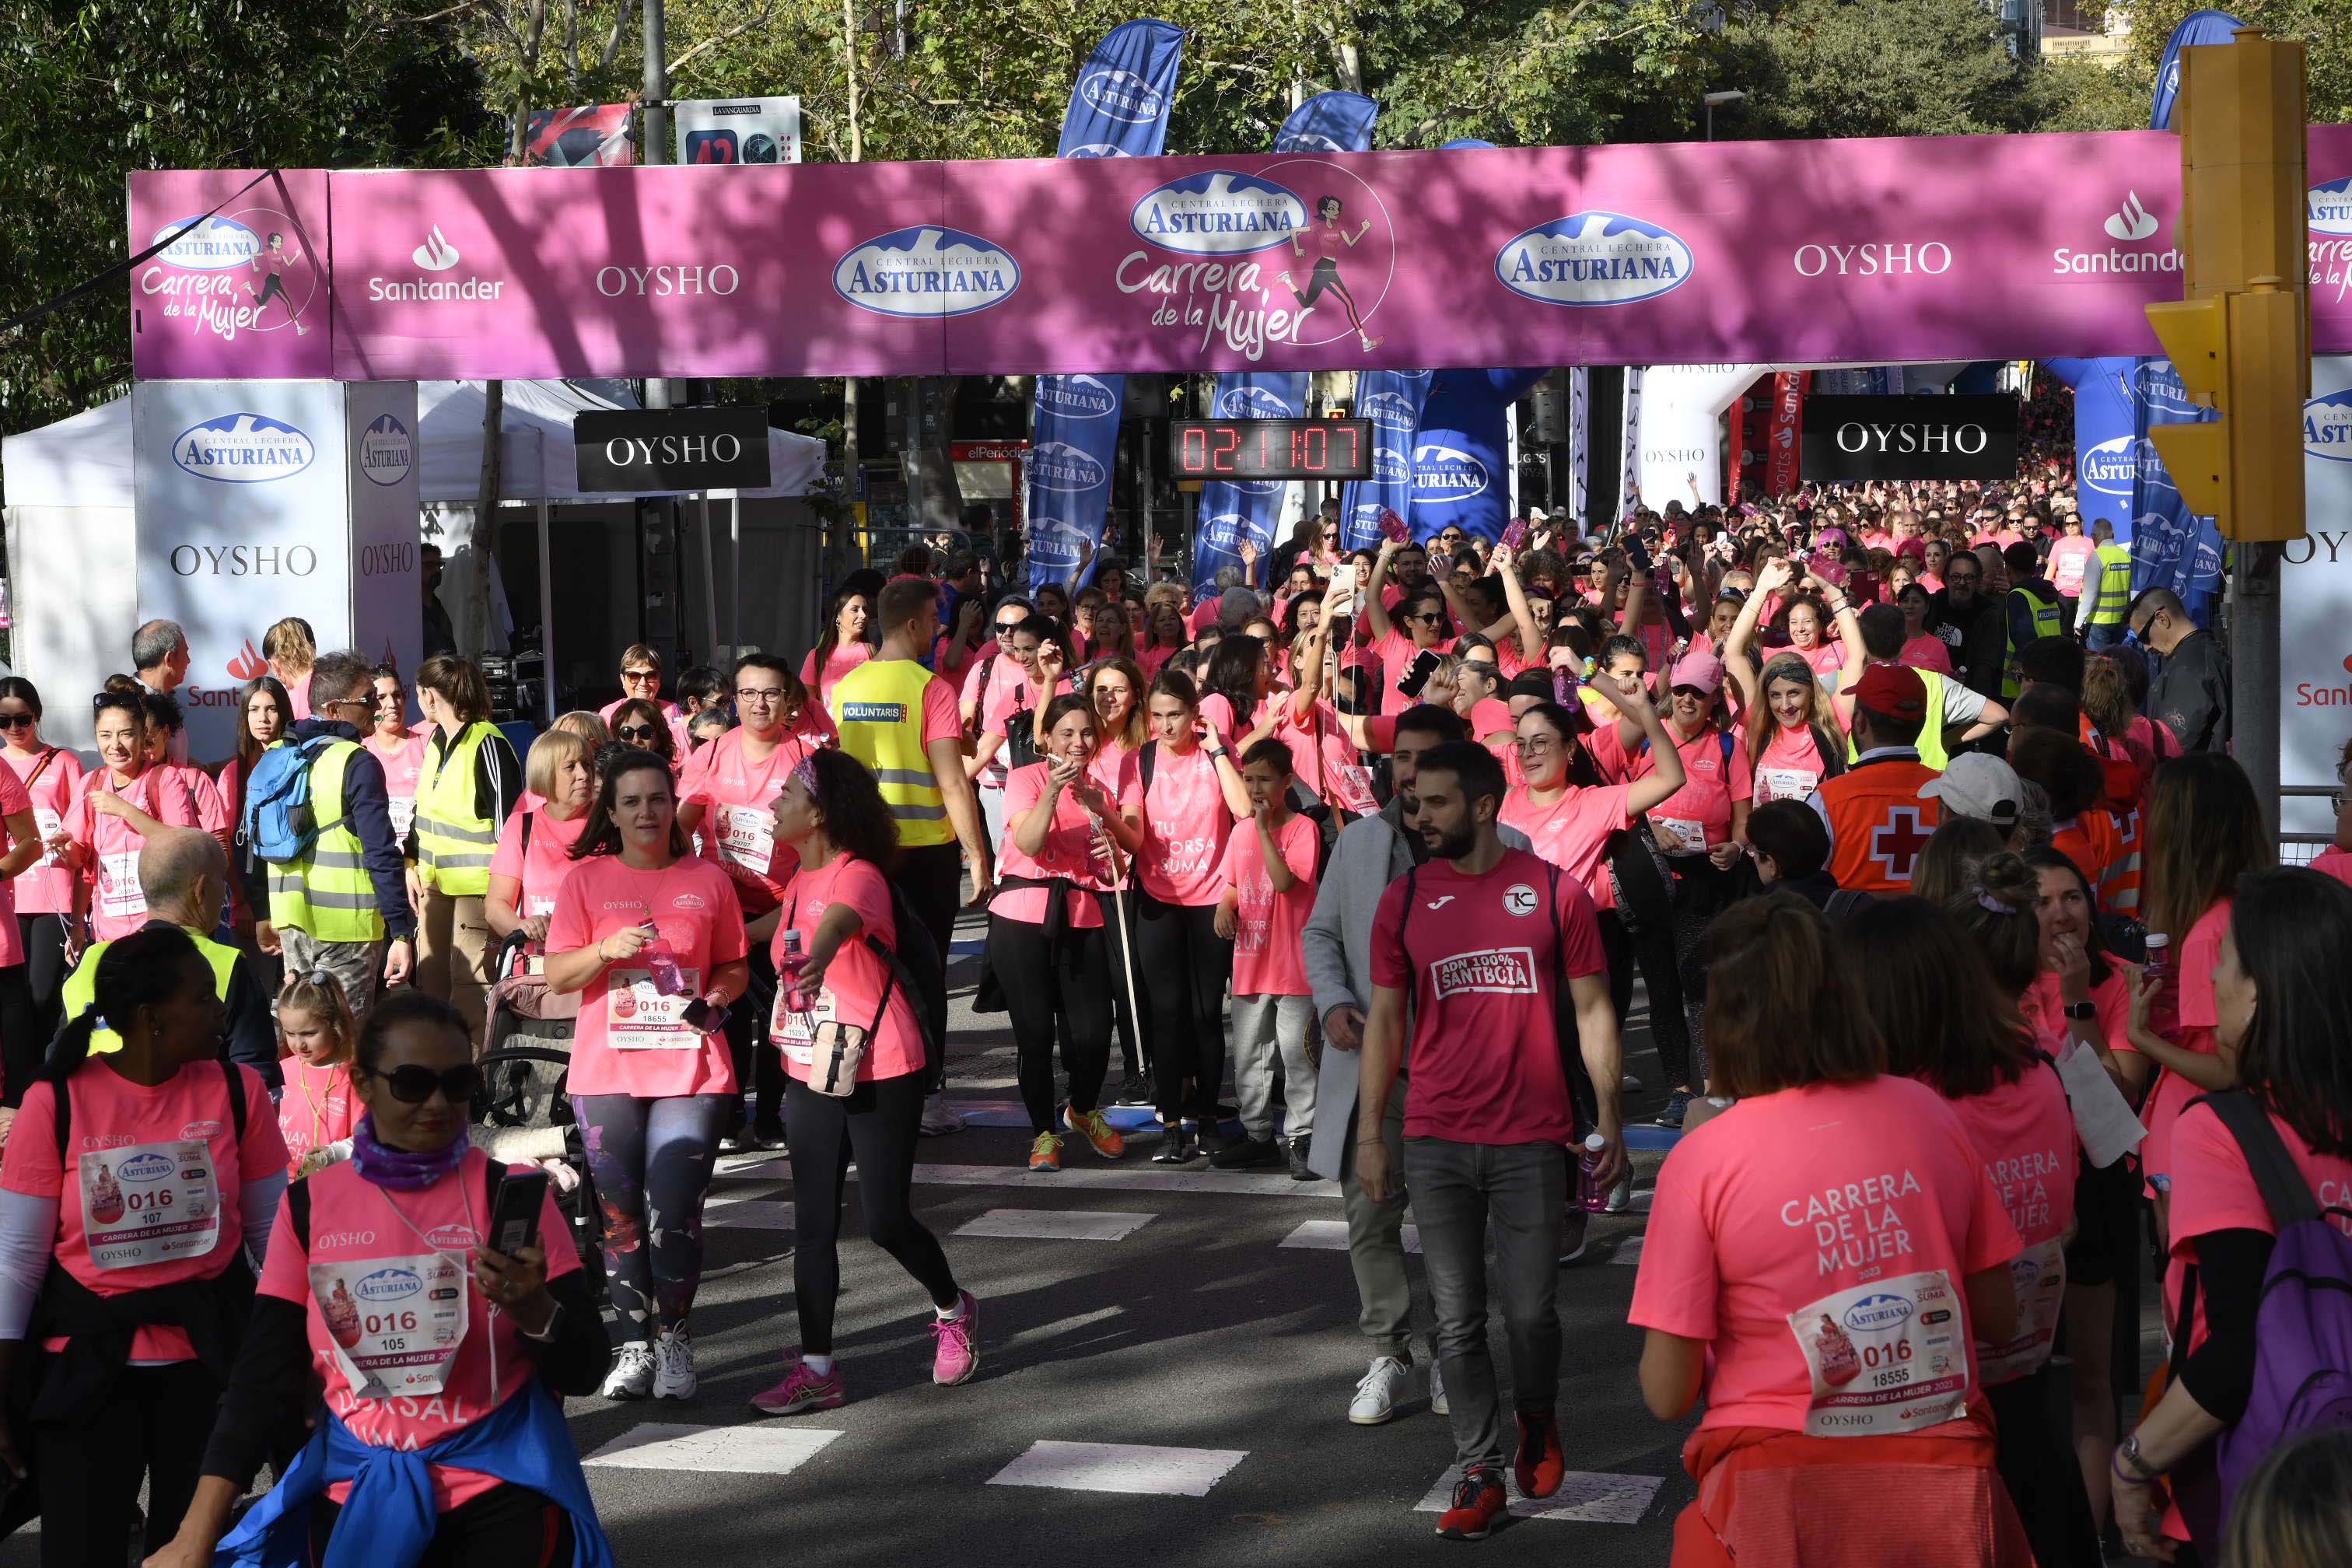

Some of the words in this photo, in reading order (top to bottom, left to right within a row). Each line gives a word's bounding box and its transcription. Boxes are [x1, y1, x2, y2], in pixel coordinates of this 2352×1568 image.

[1087, 80, 1157, 116] ASTURIANA
[1171, 198, 1227, 209] CENTRAL
[1233, 198, 1289, 208] LECHERA
[1144, 202, 1292, 235] ASTURIANA
[159, 235, 252, 257] ASTURIANA
[1541, 243, 1601, 254] CENTRAL
[1608, 243, 1671, 253] LECHERA
[2308, 240, 2352, 263] arre
[876, 257, 933, 268] CENTRAL
[941, 256, 999, 266] LECHERA
[1510, 248, 1678, 283] ASTURIANA
[1794, 242, 1952, 277] OYSHO
[2053, 247, 2183, 275] Santand
[142, 266, 233, 295] Carrera
[597, 265, 739, 297] OYSHO
[848, 260, 1006, 294] ASTURIANA
[1115, 250, 1262, 294] Carrera
[369, 276, 504, 302] Santander
[163, 297, 180, 317] de
[184, 294, 197, 317] la
[194, 292, 268, 341] Mujer
[1151, 296, 1178, 327] de
[1184, 292, 1203, 327] la
[1199, 289, 1315, 362] Mujer
[1035, 381, 1108, 411] ASTURIANA
[1363, 401, 1414, 428] ASTURIANA
[254, 436, 299, 445] LECHERA
[1836, 422, 1987, 454] OYSHO
[184, 439, 304, 466] ASTURIANA
[364, 440, 408, 467] ASTURIANA
[606, 433, 740, 467] OYSHO
[968, 446, 1020, 459] elPeriódi
[1183, 428, 1357, 471] 02:11:07
[1646, 448, 1705, 463] OYSHO
[1032, 463, 1097, 484] STURIANA
[2088, 459, 2134, 481] ASTU
[1030, 538, 1080, 558] TURIAN
[1206, 524, 1265, 552] ASTURNA
[170, 544, 317, 577] OYSHO
[362, 541, 414, 576] OYSHO
[843, 706, 900, 718] VOLUNTARIS
[393, 816, 405, 824] 16
[1155, 821, 1174, 835] TU
[733, 829, 755, 841] 016
[604, 901, 642, 910] OYSHO
[1235, 933, 1269, 950] SUM
[1442, 959, 1467, 973] ADN
[1472, 954, 1514, 967] 100%
[640, 1000, 670, 1012] 016
[83, 1135, 135, 1148] OYSHO
[122, 1165, 172, 1178] ASTURIANA
[1985, 1149, 2060, 1185] RRERA
[128, 1189, 173, 1209] 016
[1781, 1168, 1922, 1227] CARRERA
[2021, 1179, 2048, 1204] LA
[142, 1212, 162, 1224] 107
[1815, 1214, 1855, 1247] DE
[1864, 1202, 1902, 1234] LA
[102, 1230, 138, 1242] CARRERA
[163, 1224, 188, 1234] MUJER
[319, 1230, 376, 1249] OYSHO
[429, 1234, 474, 1245] ASTURIAN
[101, 1247, 142, 1260] OYSHO
[171, 1238, 211, 1251] Santander
[1818, 1229, 1913, 1276] MUJER
[361, 1282, 418, 1296] ASTURIANA
[366, 1311, 418, 1333] 016
[1850, 1306, 1909, 1327] ASTURIANA
[381, 1339, 405, 1351] 105
[1864, 1339, 1913, 1367] 016
[380, 1357, 391, 1366] DE
[393, 1356, 404, 1365] LA
[406, 1353, 435, 1363] MUJER
[1872, 1369, 1909, 1388] 18555
[1828, 1395, 1874, 1405] CARRERA
[1876, 1394, 1888, 1402] DE
[1890, 1391, 1901, 1400] LA
[1902, 1384, 1932, 1398] MUJER
[1821, 1415, 1873, 1426] OYSHO
